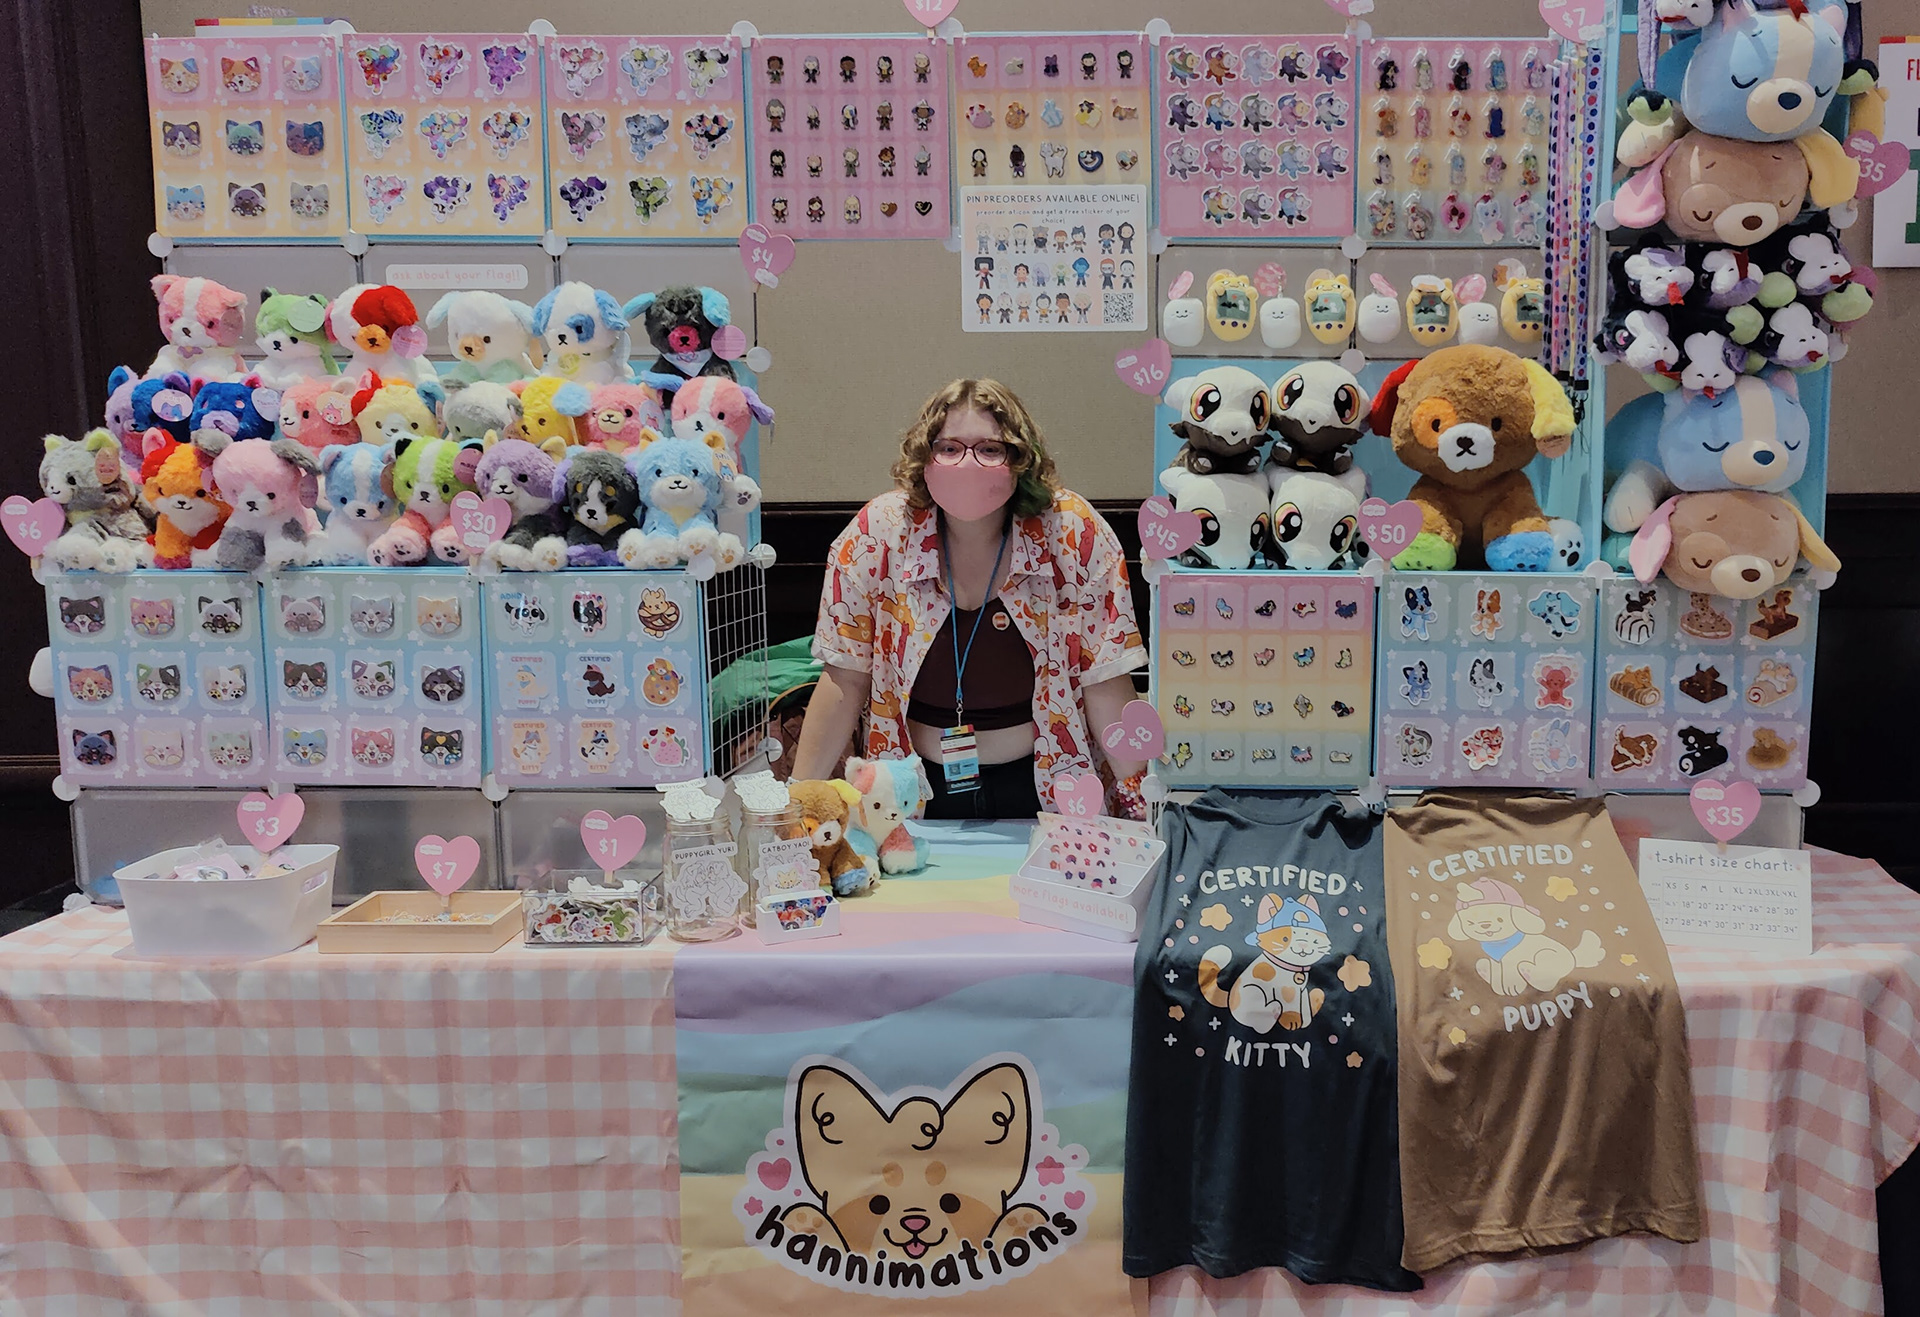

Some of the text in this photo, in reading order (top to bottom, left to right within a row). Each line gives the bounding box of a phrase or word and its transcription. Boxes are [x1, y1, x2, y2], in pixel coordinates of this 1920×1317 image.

[1562, 7, 1586, 28] $7
[1857, 156, 1887, 182] 35
[966, 194, 1140, 203] PIN PREORDERS AVAILABLE ONLINE!
[976, 208, 1006, 216] preorder
[1046, 208, 1057, 216] get
[751, 247, 773, 269] $4
[393, 269, 520, 284] ask about your flag!!
[1133, 363, 1164, 387] $16
[18, 520, 42, 540] $6
[462, 511, 497, 535] $30
[1145, 521, 1180, 551] $45
[1367, 524, 1406, 545] $50
[1128, 726, 1153, 750] $8
[1067, 796, 1087, 816] $6
[1706, 806, 1744, 826] $35
[255, 816, 280, 836] $3
[599, 838, 618, 857] $1
[674, 845, 735, 860] PUPPYGIRL YURI
[761, 840, 810, 854] CATBOY YAOI
[432, 861, 459, 881] $7
[1427, 844, 1574, 882] CERTIFIED
[1655, 850, 1794, 871] t-shirt size chart:
[1199, 864, 1347, 895] CERTIFIED
[1665, 881, 1677, 890] XS
[1684, 883, 1690, 891] S
[1732, 886, 1744, 894] XL
[1748, 888, 1763, 896] 2XL
[1765, 889, 1780, 897] 3XL
[1013, 885, 1129, 924] more flags available!
[1503, 981, 1595, 1033] PUPPY
[1224, 1036, 1312, 1069] KITTY
[755, 1205, 1078, 1288] hannimations
